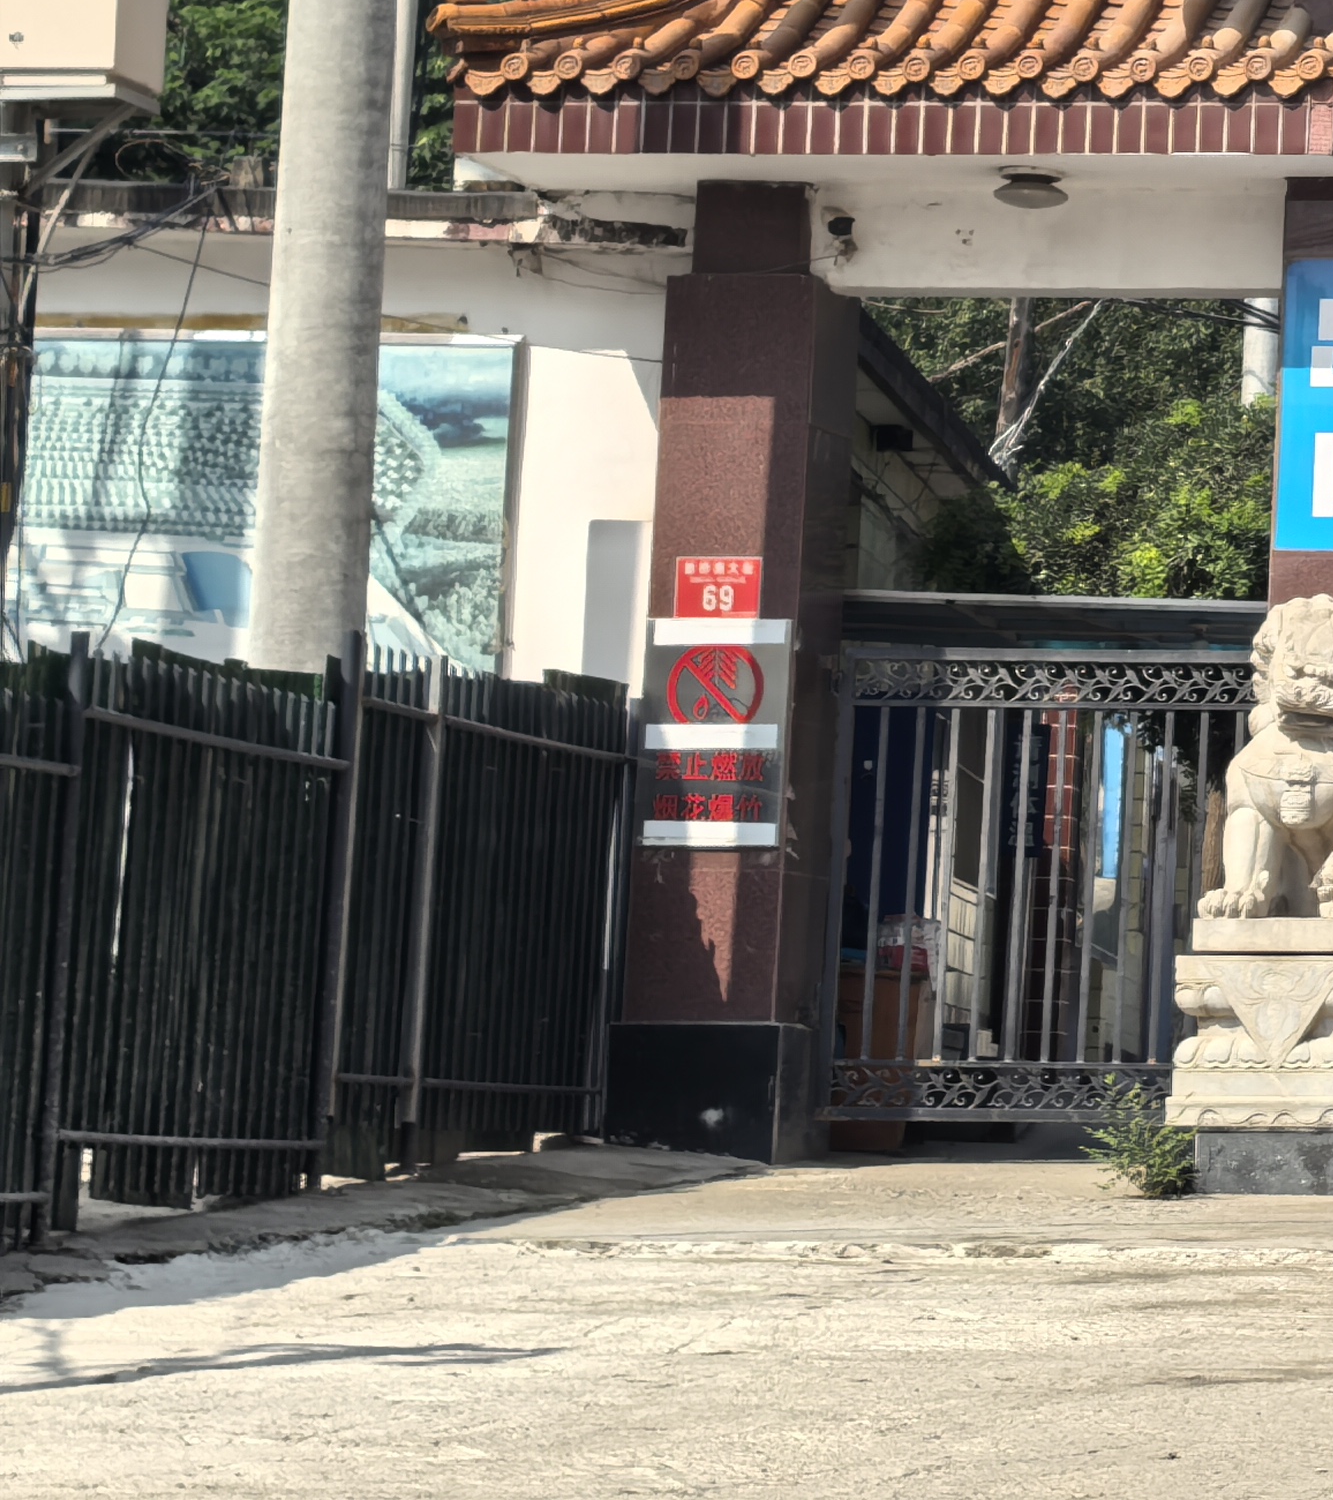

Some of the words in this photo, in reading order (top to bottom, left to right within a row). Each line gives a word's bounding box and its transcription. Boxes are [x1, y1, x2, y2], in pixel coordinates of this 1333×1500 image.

[702, 585, 735, 611] 69
[655, 751, 764, 781] 禁止燃放
[653, 793, 763, 821] 烟花爆竹
